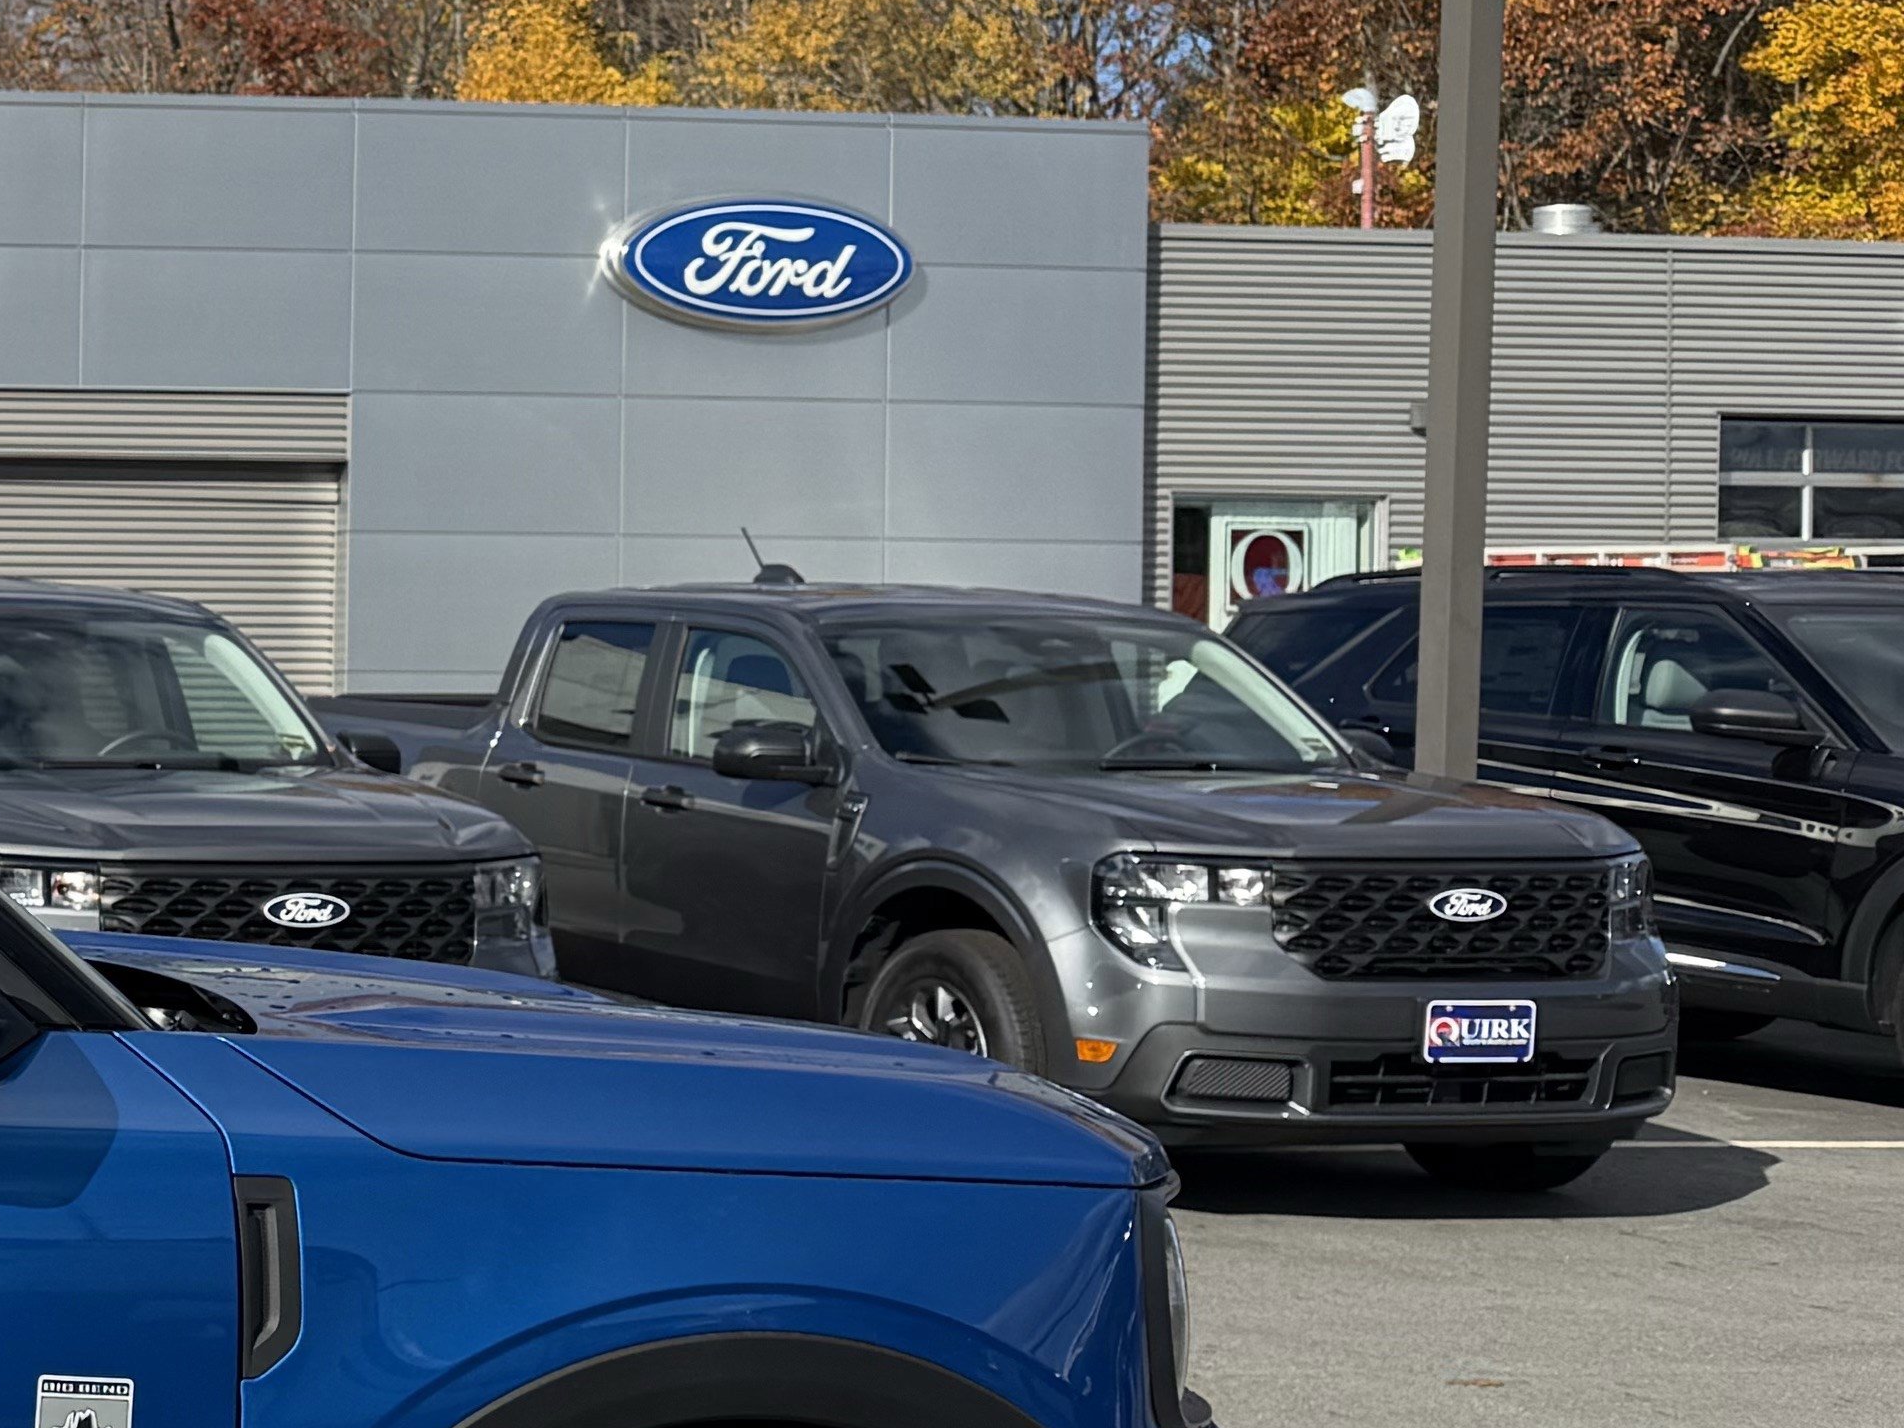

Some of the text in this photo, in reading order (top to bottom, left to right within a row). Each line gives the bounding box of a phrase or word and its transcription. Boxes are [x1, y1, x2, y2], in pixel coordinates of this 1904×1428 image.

[682, 221, 858, 299] Ford
[279, 897, 335, 922] Ford
[1443, 892, 1494, 916] Ford
[1429, 1017, 1530, 1047] QUIRK
[42, 1382, 128, 1395] BIG BEND
